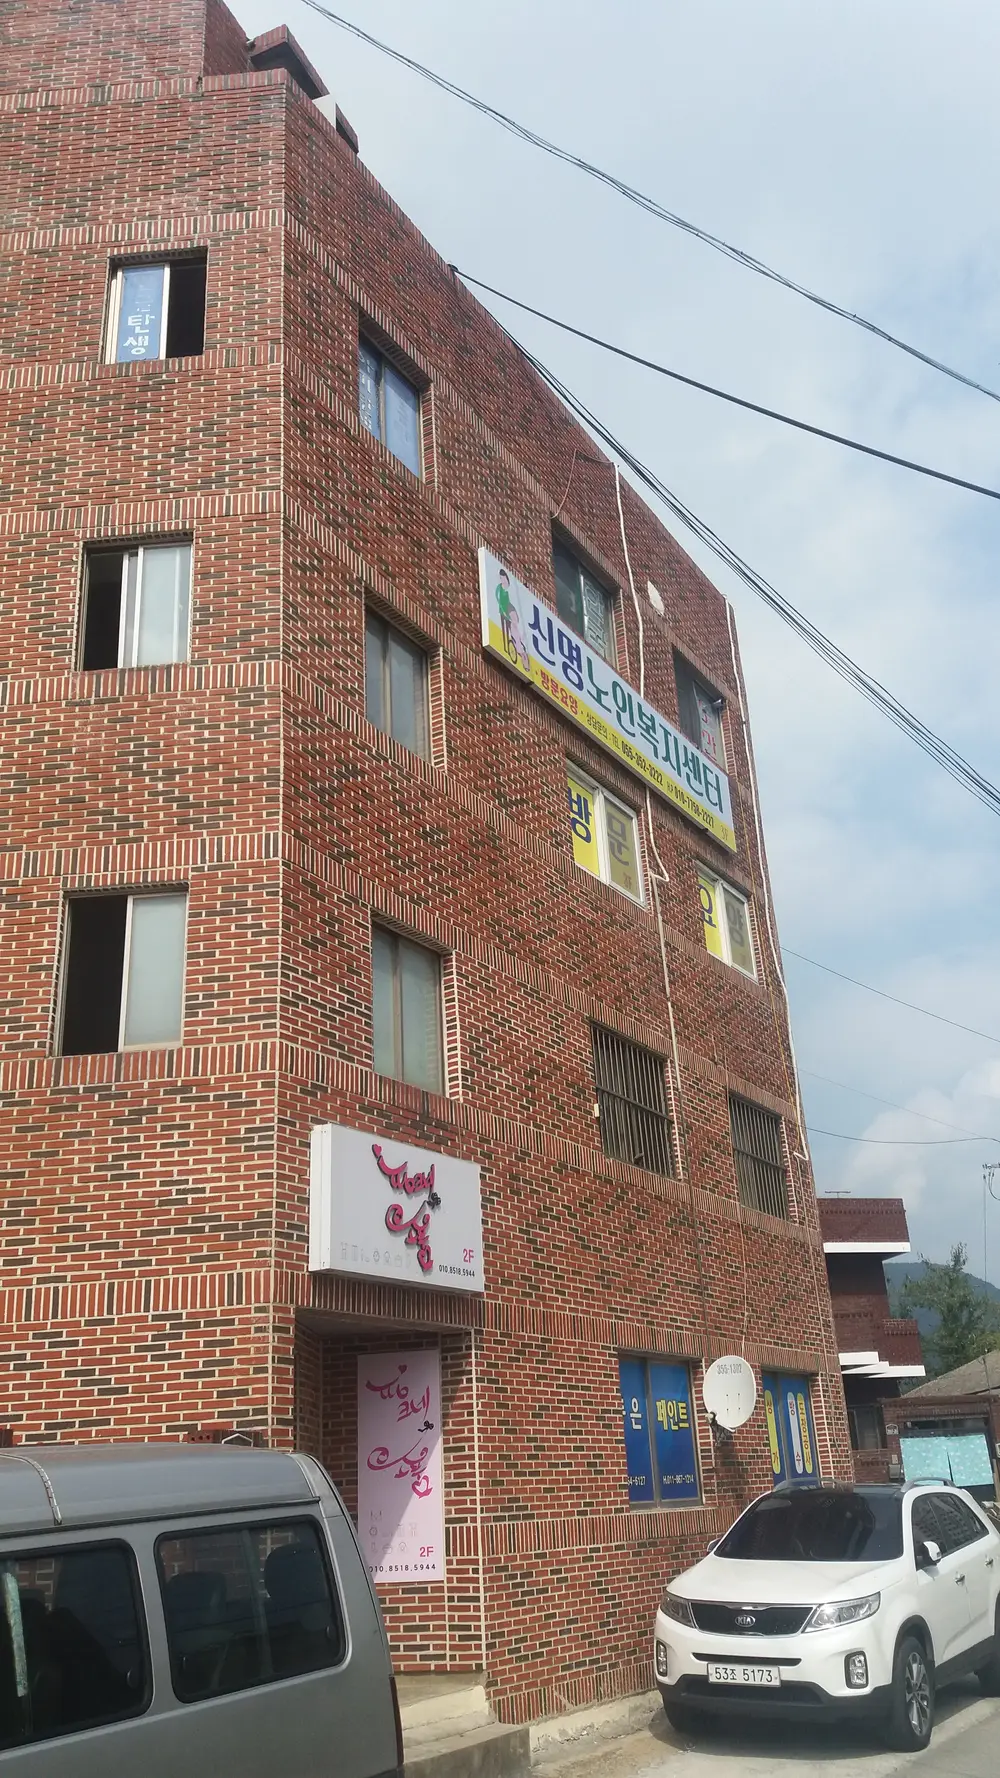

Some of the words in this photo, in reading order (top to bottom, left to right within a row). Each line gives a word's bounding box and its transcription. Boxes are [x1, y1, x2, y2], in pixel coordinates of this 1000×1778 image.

[538, 669, 579, 716] 방문요양
[462, 1248, 475, 1264] 2F
[438, 1264, 475, 1277] 010.8518.5944
[656, 1398, 689, 1431] 페인트
[419, 1546, 434, 1558] 2F
[715, 1666, 738, 1681] 53조
[742, 1669, 773, 1683] 5173
